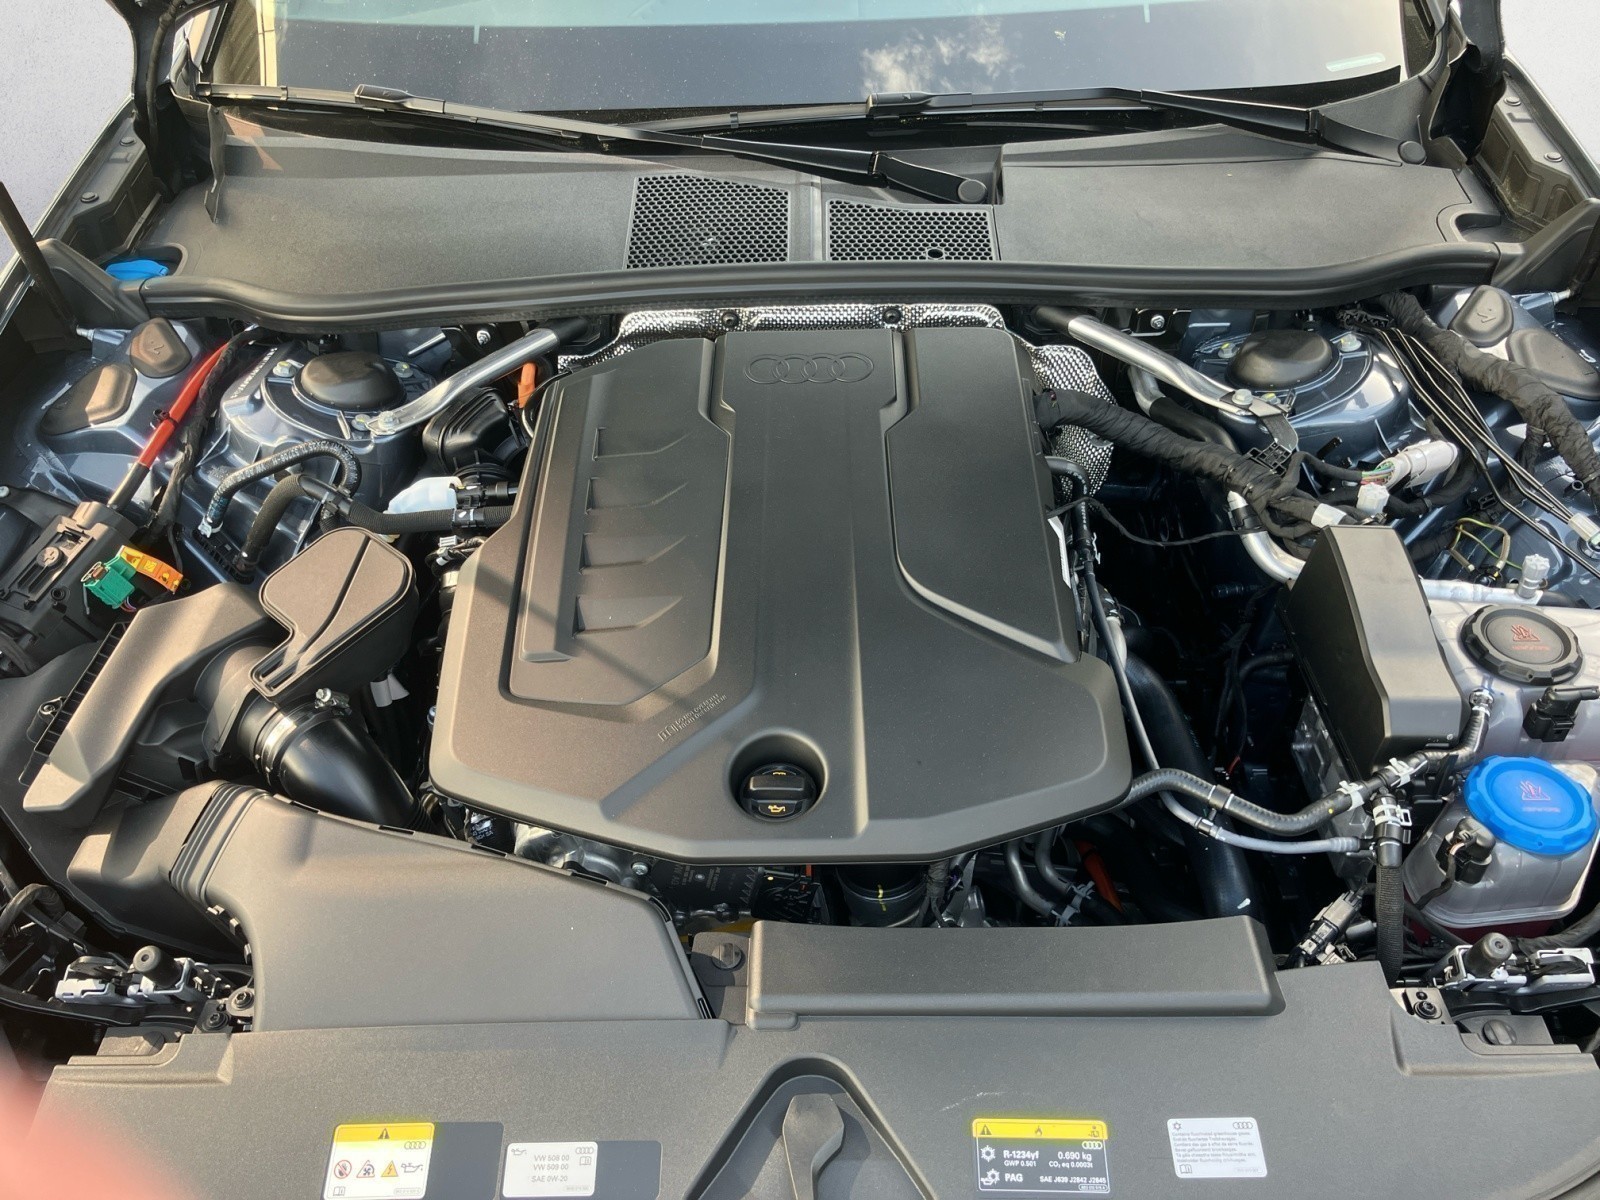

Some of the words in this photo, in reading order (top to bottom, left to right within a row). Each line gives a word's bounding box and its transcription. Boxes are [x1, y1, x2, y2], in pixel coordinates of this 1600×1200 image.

[1003, 1150, 1039, 1159] R-1234yf
[1058, 1151, 1080, 1160] 0.690
[1082, 1152, 1092, 1161] kg
[1004, 1173, 1023, 1182] PAG
